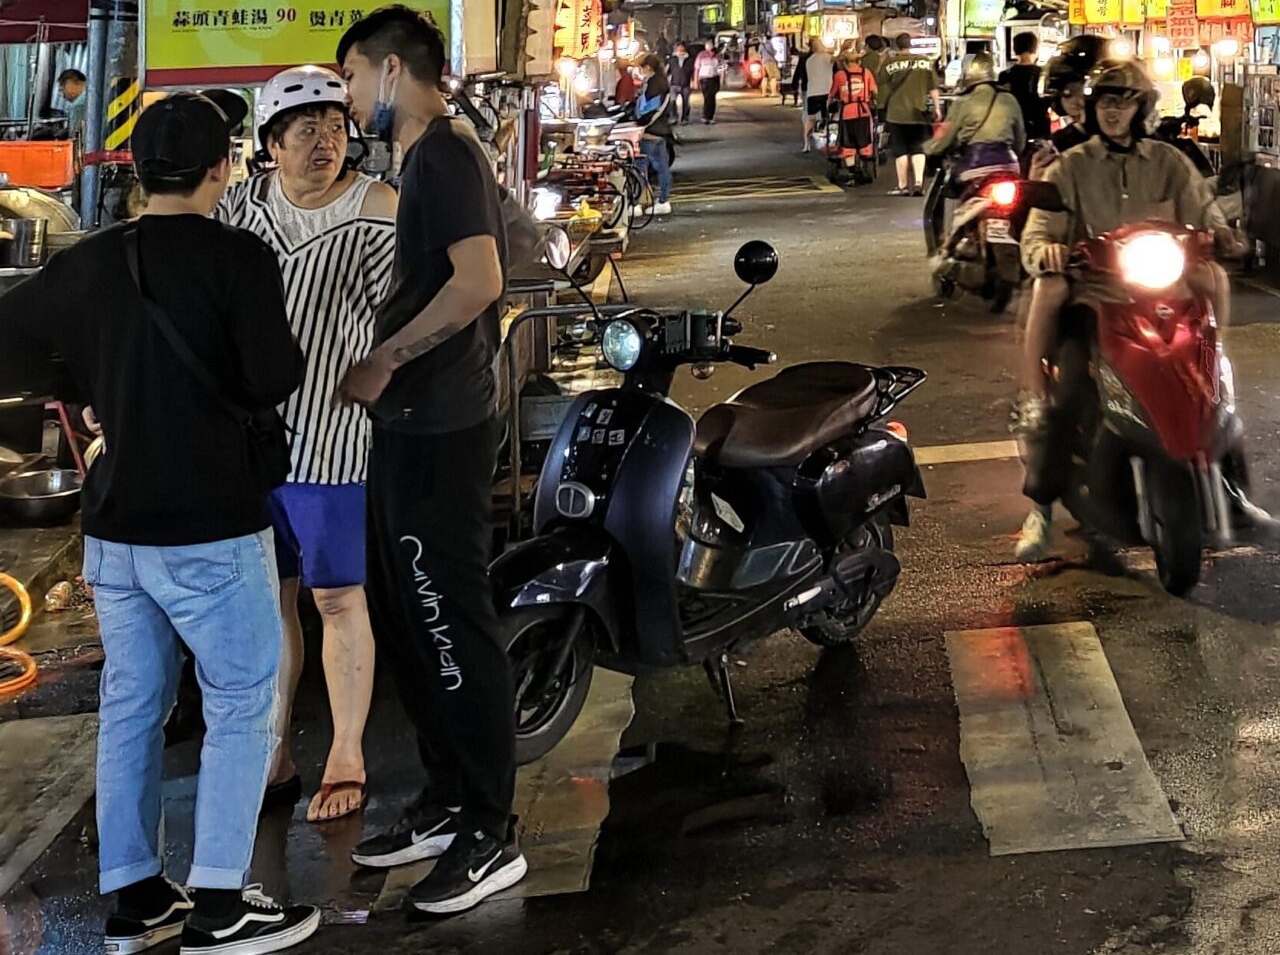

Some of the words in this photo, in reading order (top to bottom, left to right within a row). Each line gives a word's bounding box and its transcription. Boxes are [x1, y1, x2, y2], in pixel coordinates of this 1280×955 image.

[172, 8, 269, 29] 蒜頭青蛙湯
[275, 7, 297, 23] 90
